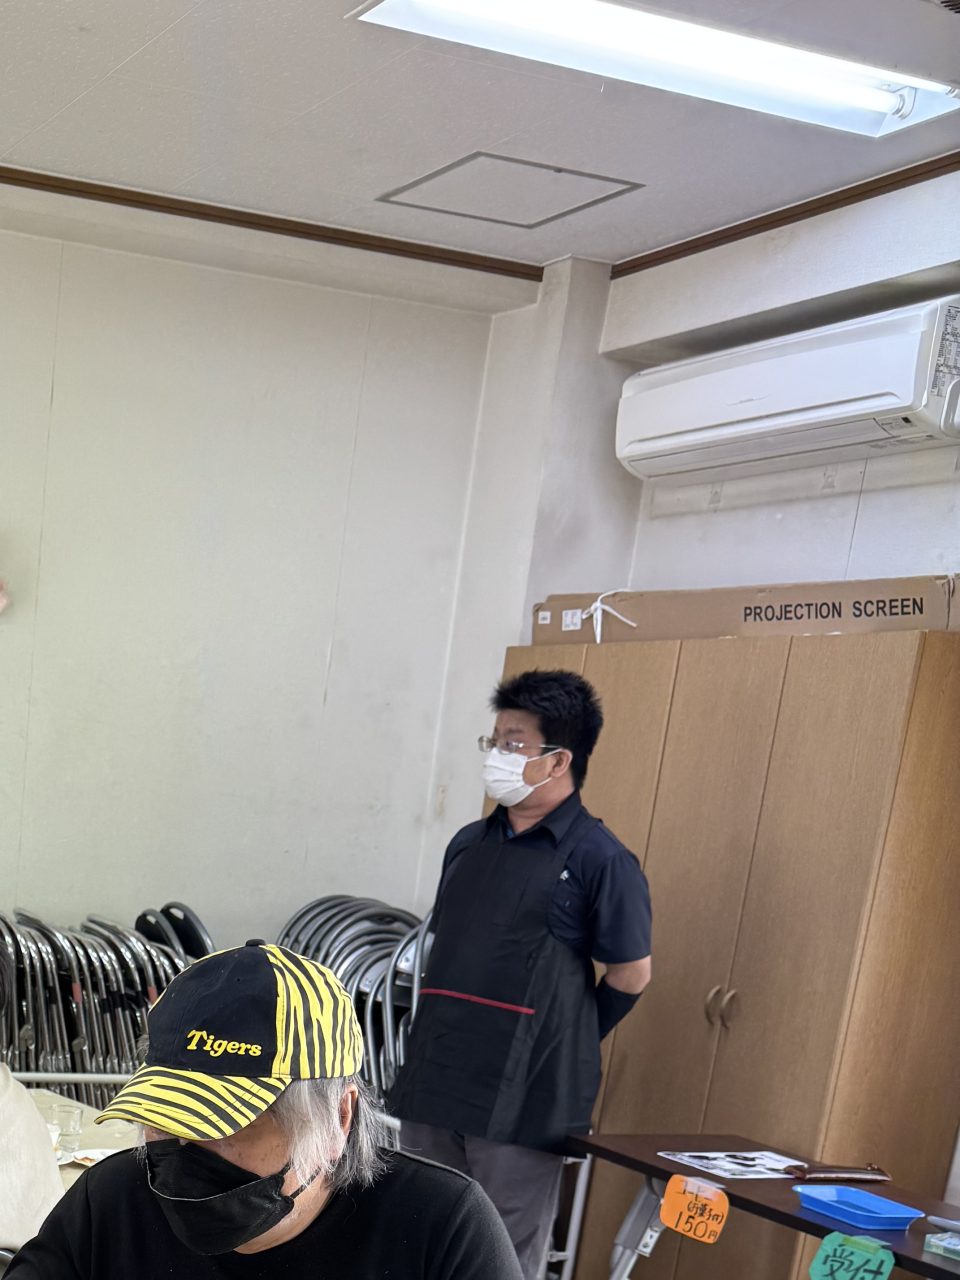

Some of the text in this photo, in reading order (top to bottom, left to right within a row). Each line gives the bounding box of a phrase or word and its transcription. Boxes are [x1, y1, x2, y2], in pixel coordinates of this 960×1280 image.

[743, 597, 924, 622] PROJECTION SCREEN
[187, 1029, 262, 1057] Tigers
[674, 1211, 719, 1240] 150円
